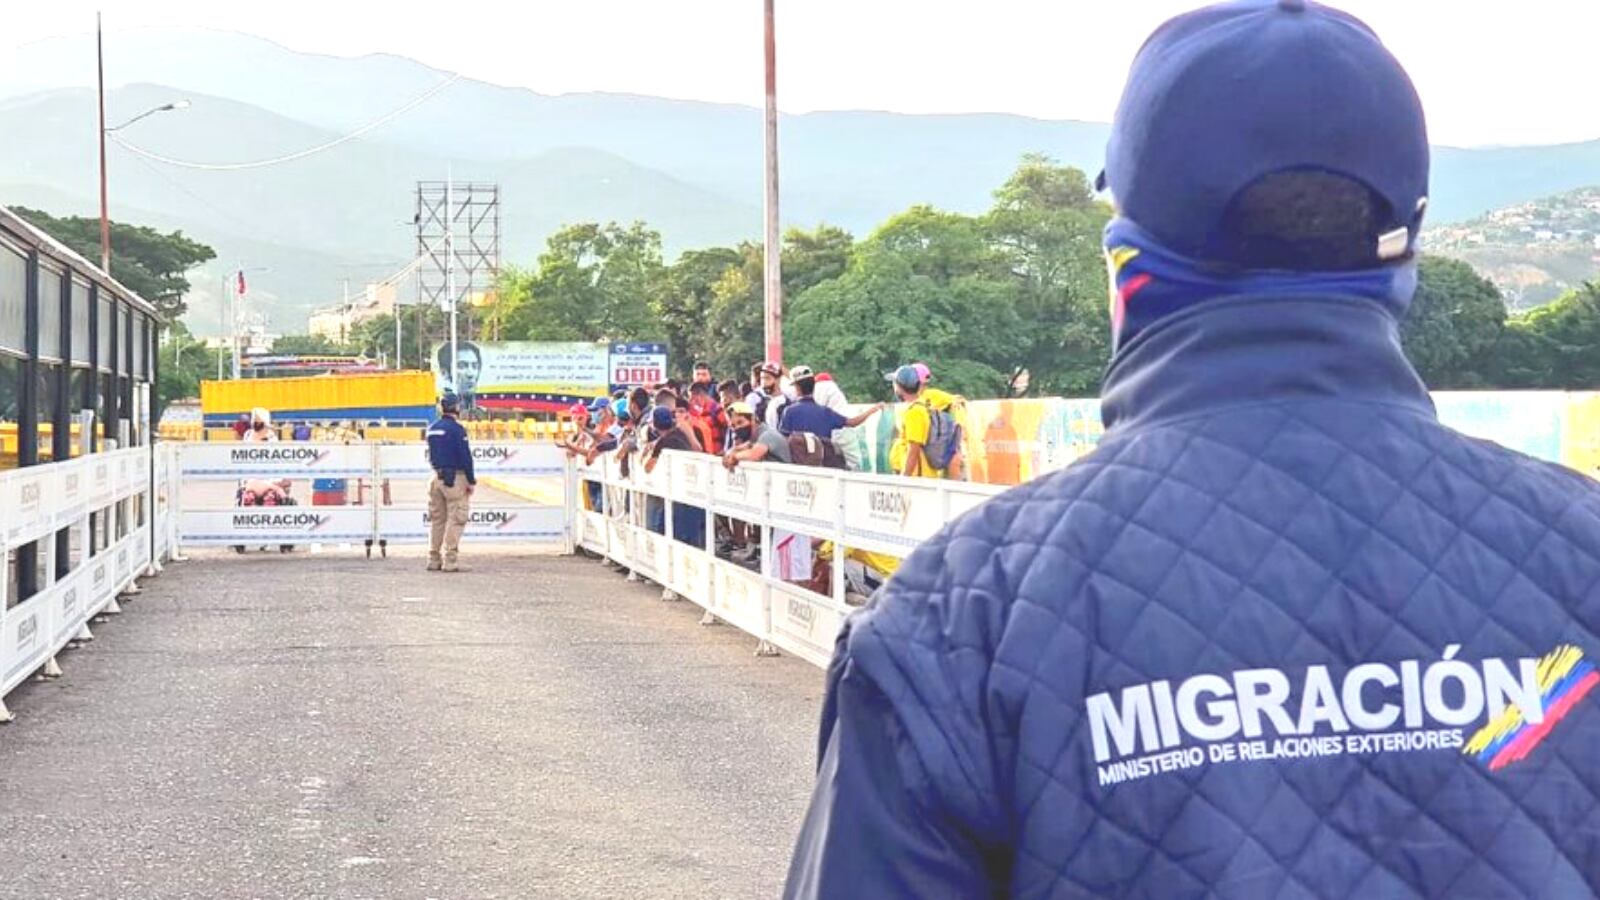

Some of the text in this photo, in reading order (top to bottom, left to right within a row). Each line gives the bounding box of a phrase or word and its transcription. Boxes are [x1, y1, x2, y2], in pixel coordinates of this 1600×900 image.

[231, 446, 319, 461] MIGRACIÓN
[424, 445, 507, 460] MCIÓN
[232, 511, 320, 525] MIGRACIÓN
[423, 509, 507, 524] MCIÓN
[1085, 644, 1544, 762] MIGRACIÓN
[1097, 729, 1464, 786] MINISTERIO DE RELACIONES EXTERIORES
